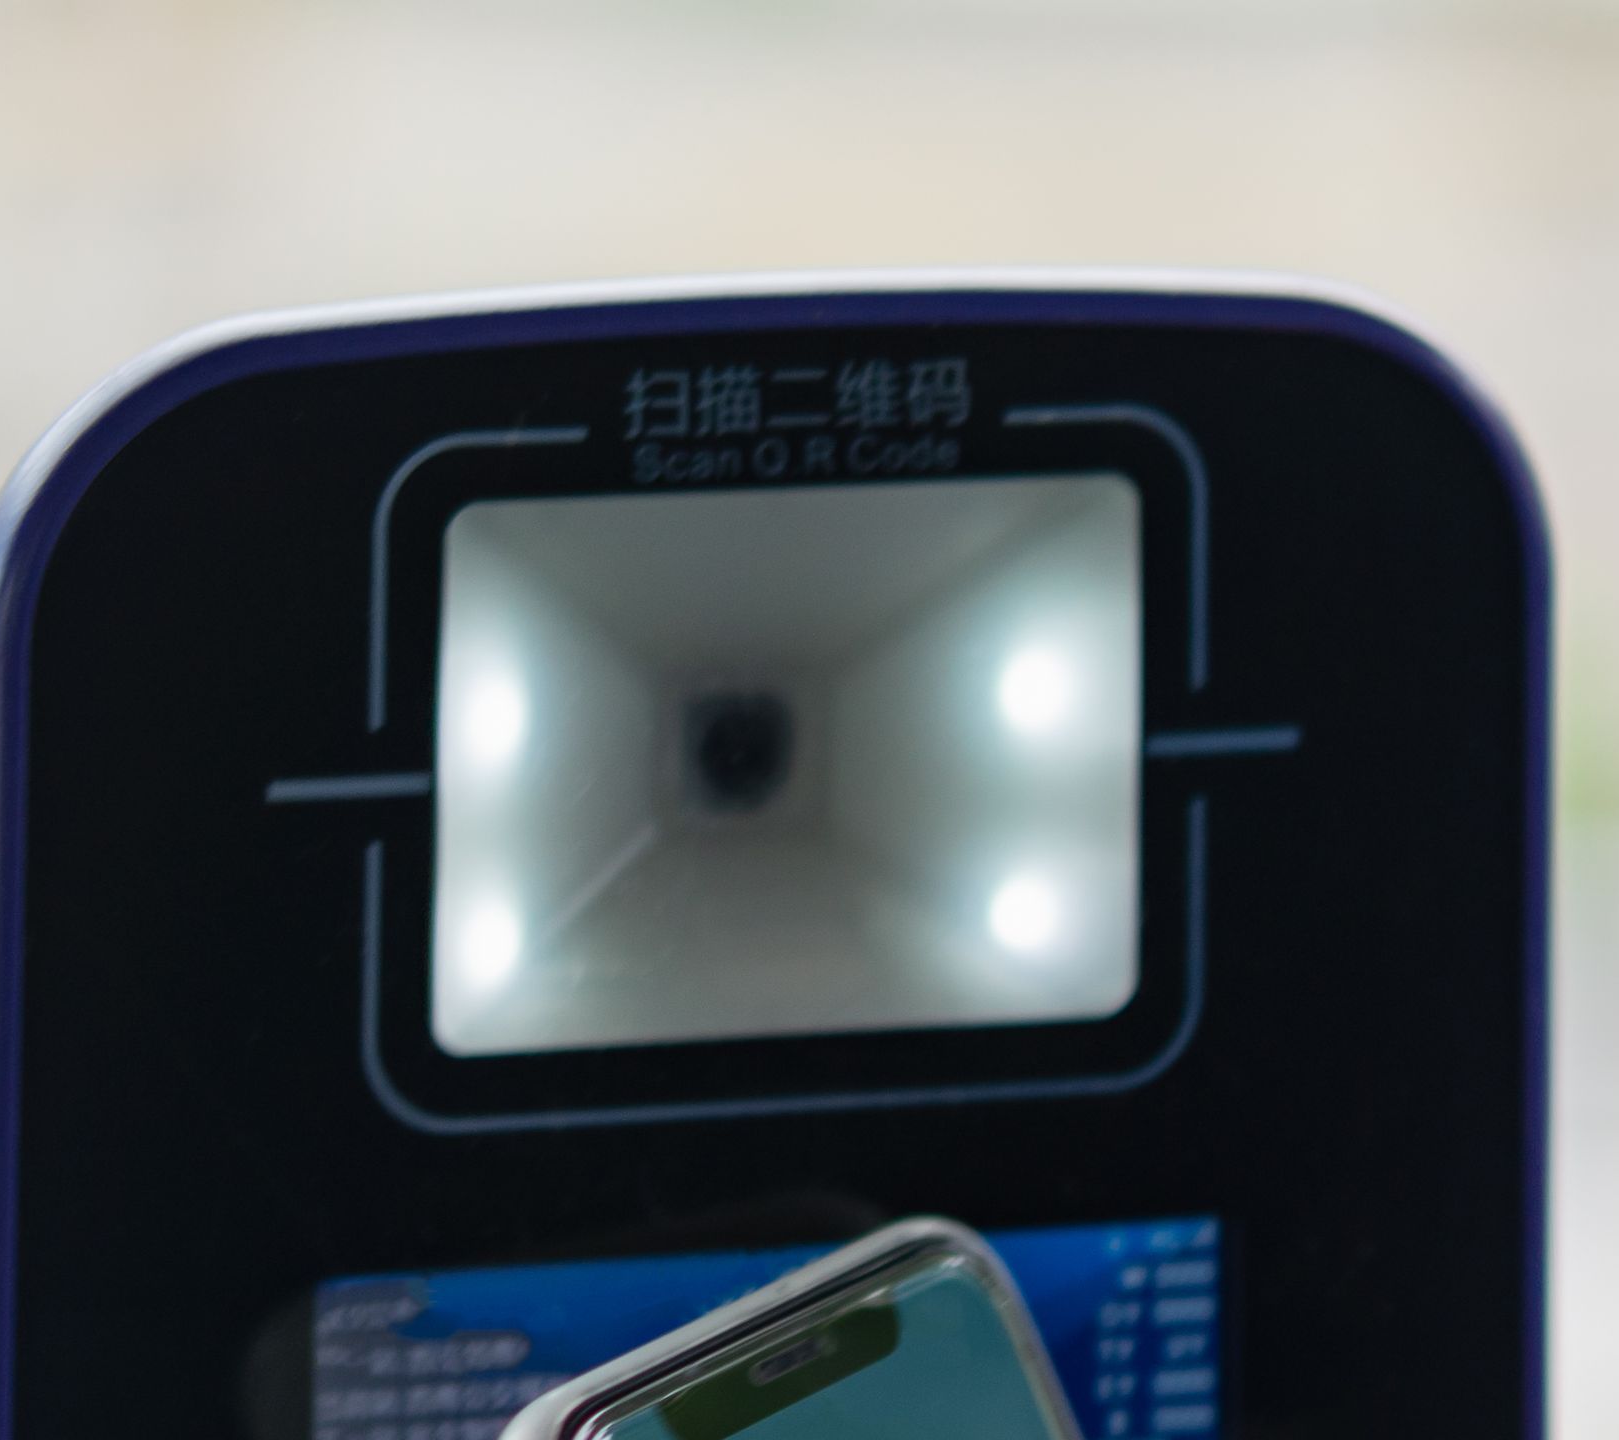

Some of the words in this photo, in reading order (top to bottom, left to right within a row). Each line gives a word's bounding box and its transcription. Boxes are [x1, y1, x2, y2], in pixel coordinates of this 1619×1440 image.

[622, 356, 973, 441] 扫描二维码
[632, 442, 743, 483] Scan
[846, 430, 962, 472] Code
